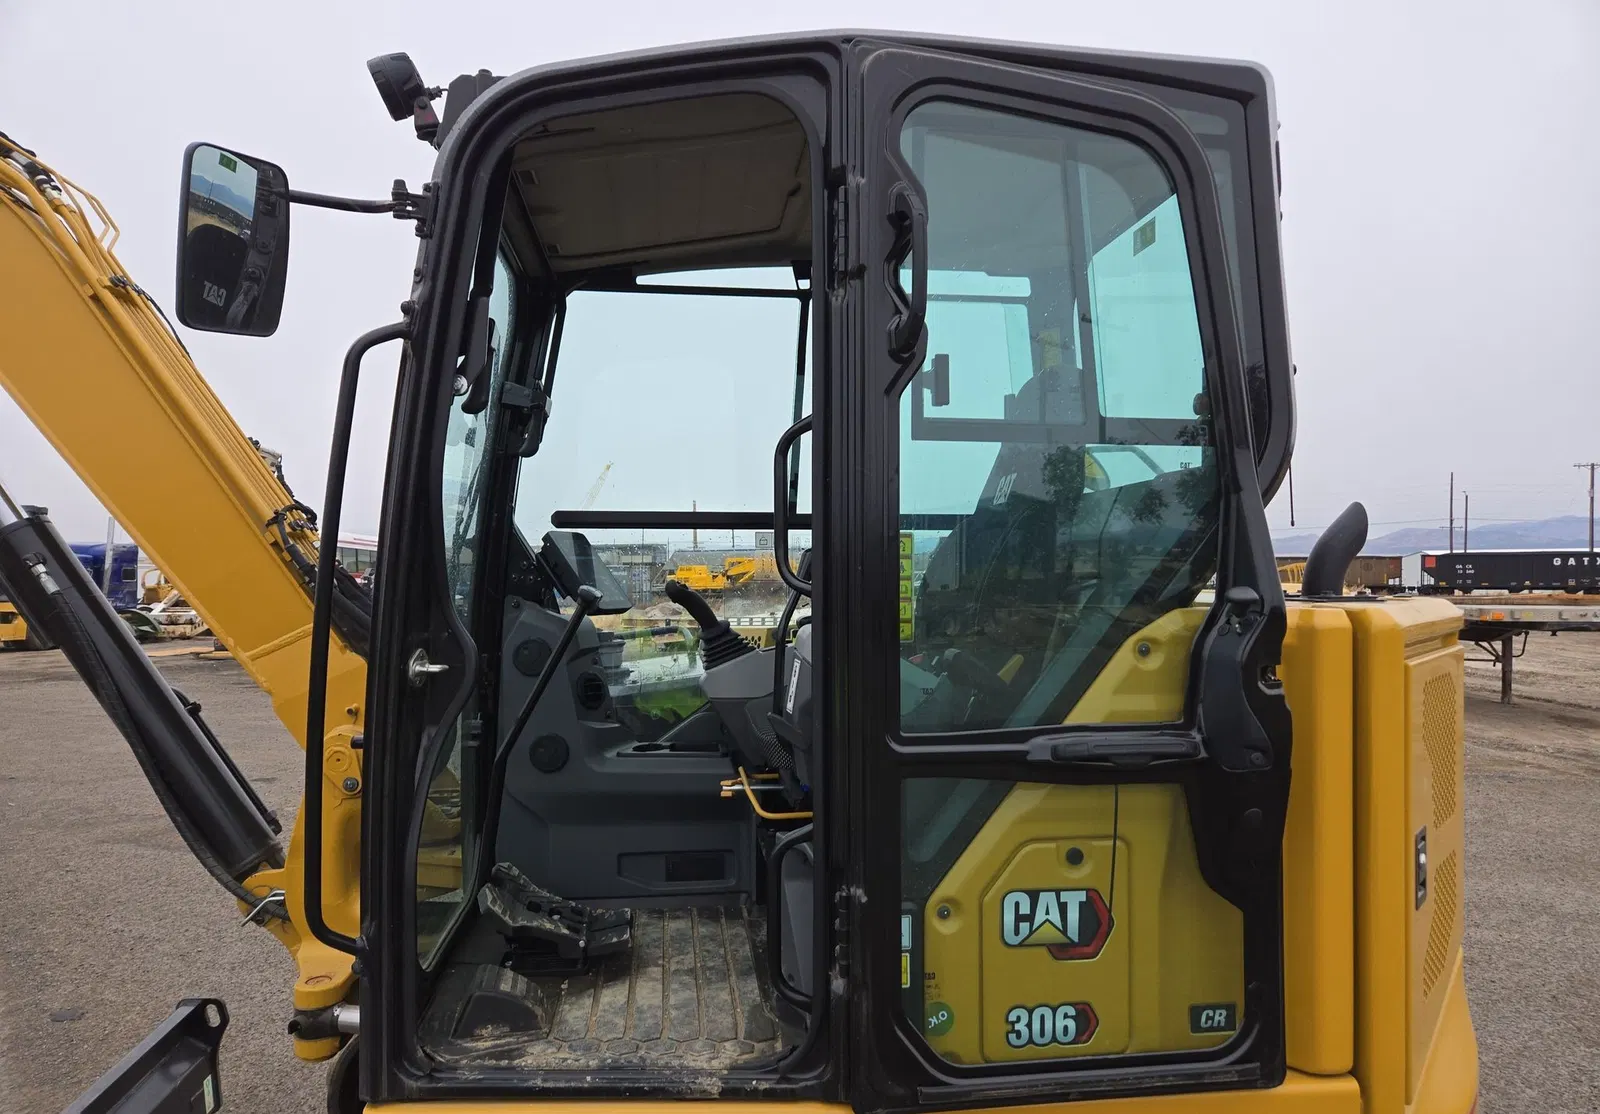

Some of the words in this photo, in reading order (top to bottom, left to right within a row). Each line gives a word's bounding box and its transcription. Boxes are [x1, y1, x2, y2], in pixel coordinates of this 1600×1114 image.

[993, 473, 1017, 505] CAT
[1003, 890, 1087, 946] CAT
[1008, 1005, 1077, 1047] 306
[1200, 1009, 1227, 1028] CR
